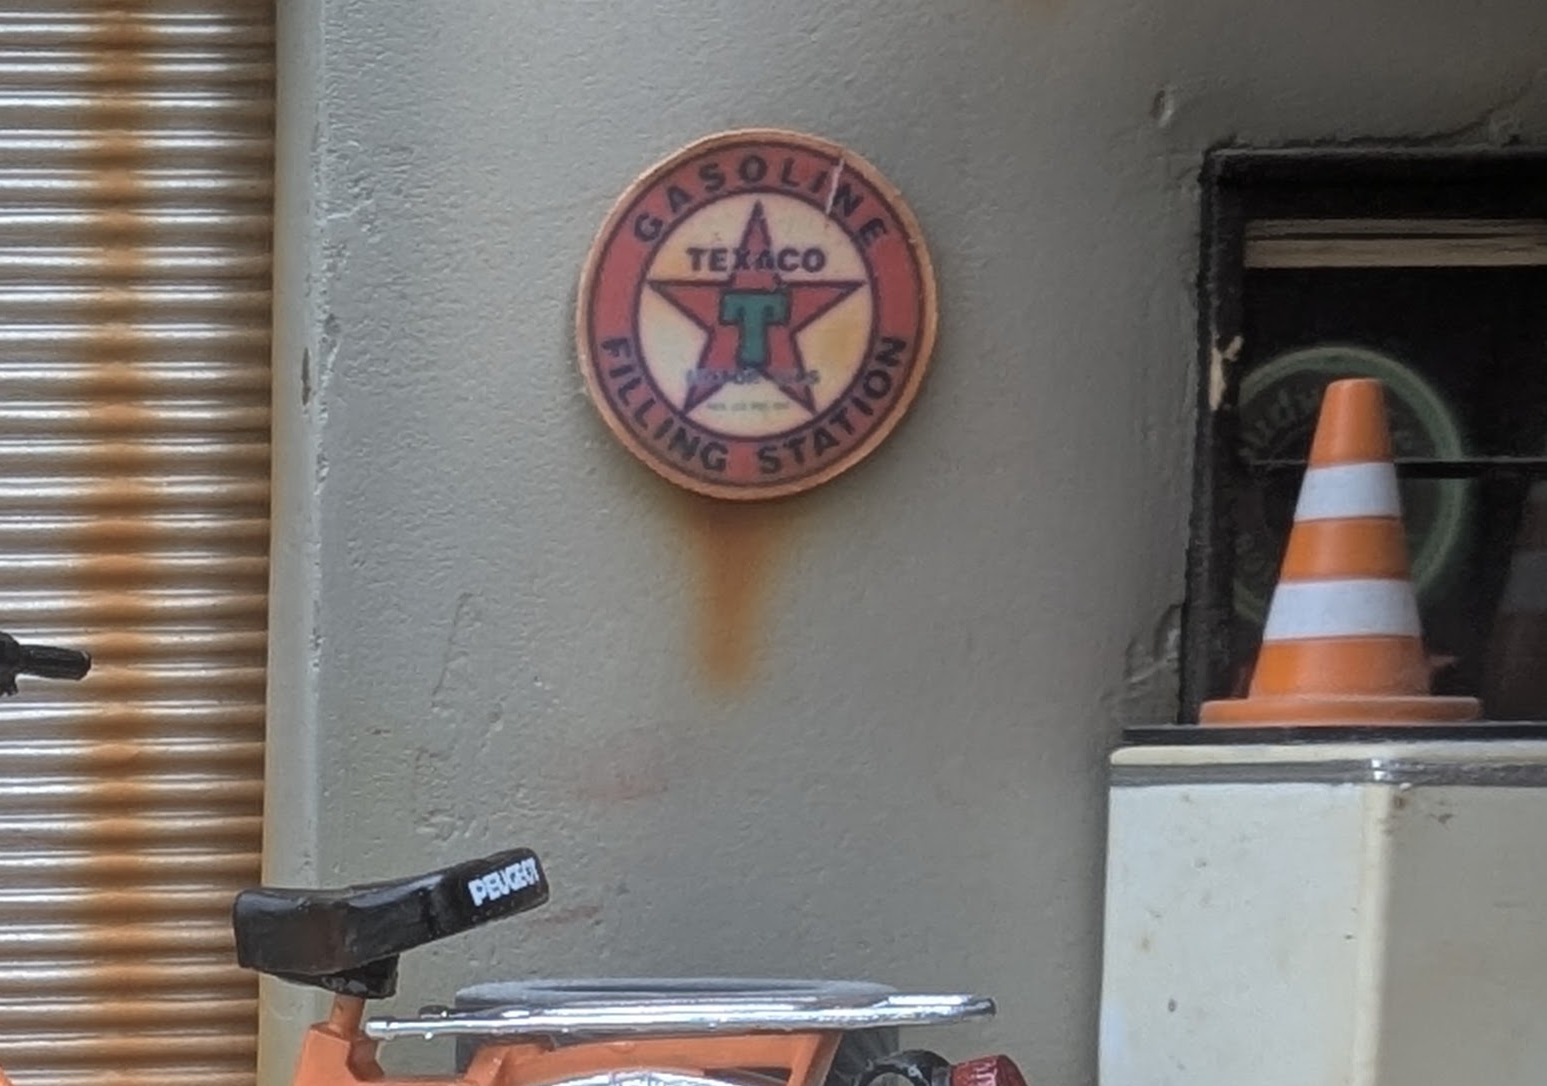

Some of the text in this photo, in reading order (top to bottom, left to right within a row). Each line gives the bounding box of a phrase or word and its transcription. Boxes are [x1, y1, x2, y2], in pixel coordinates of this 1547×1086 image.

[633, 154, 888, 245] GASOLINE
[687, 247, 827, 273] TEXACO
[720, 290, 791, 369] T
[601, 335, 908, 475] FILLING STATION
